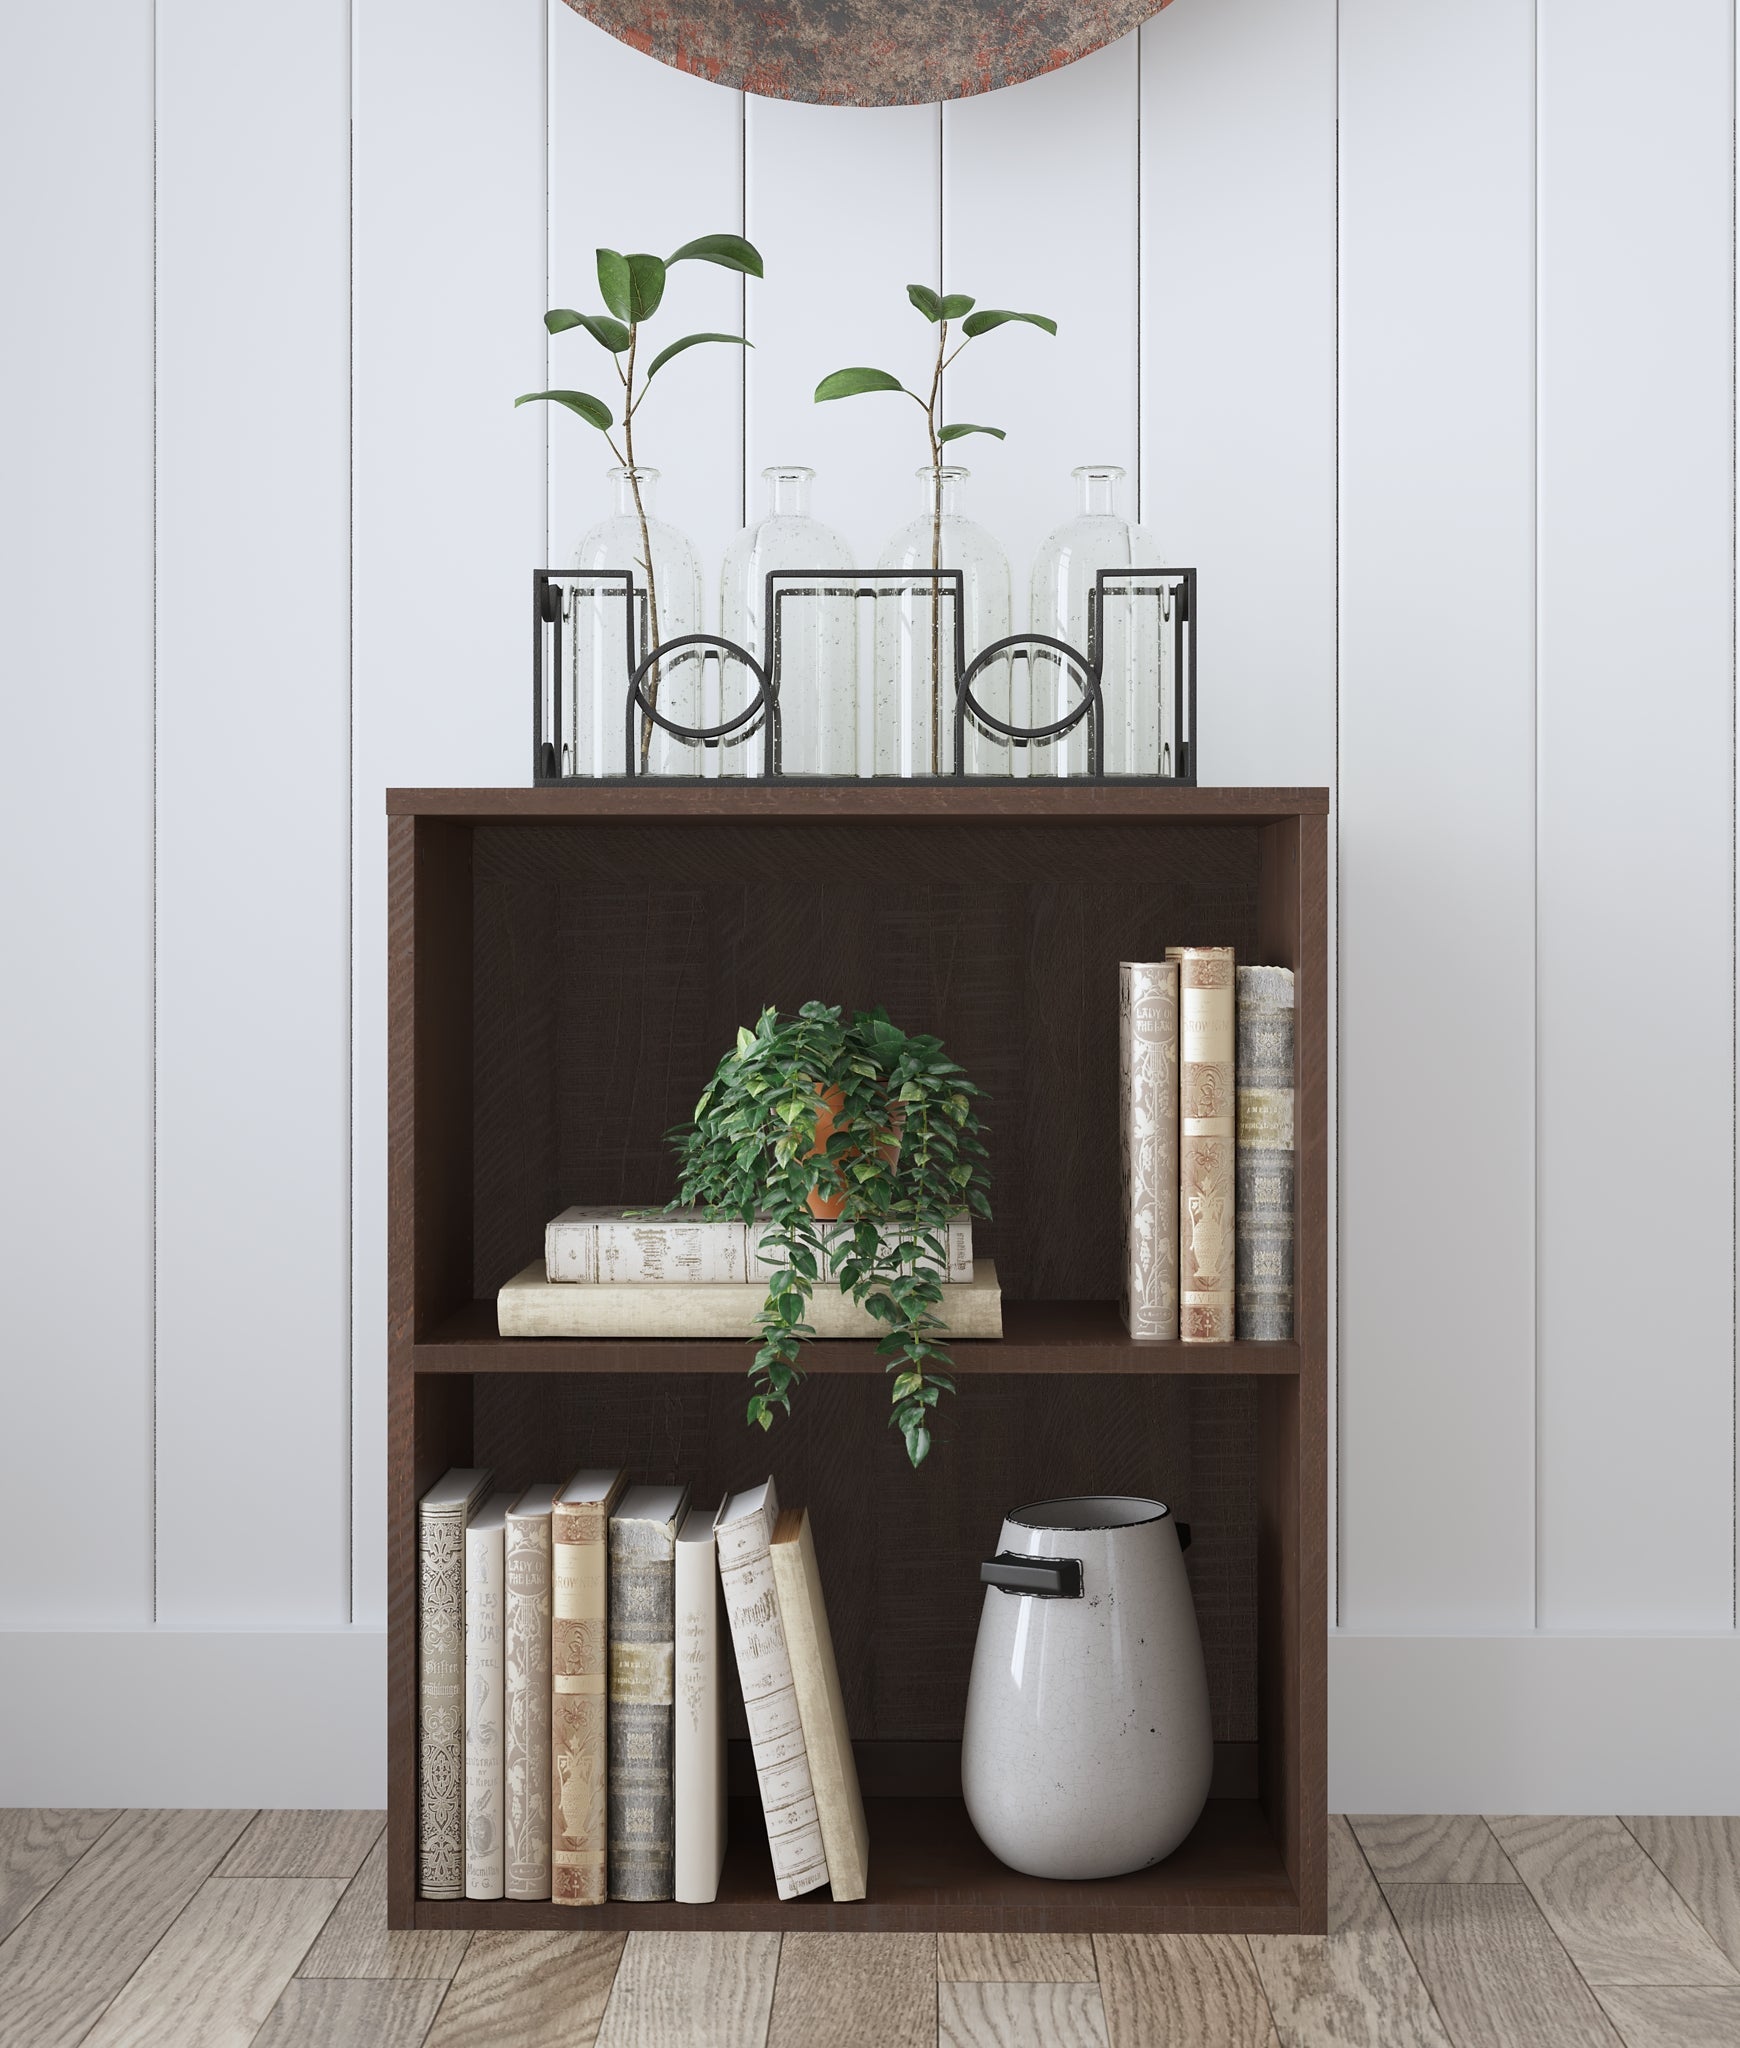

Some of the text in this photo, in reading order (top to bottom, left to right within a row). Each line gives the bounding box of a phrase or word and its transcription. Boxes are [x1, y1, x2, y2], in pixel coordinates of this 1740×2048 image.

[1136, 1007, 1161, 1019] LADY
[1136, 1019, 1153, 1032] THE
[508, 1560, 533, 1572] LADY
[507, 1573, 525, 1585] THE
